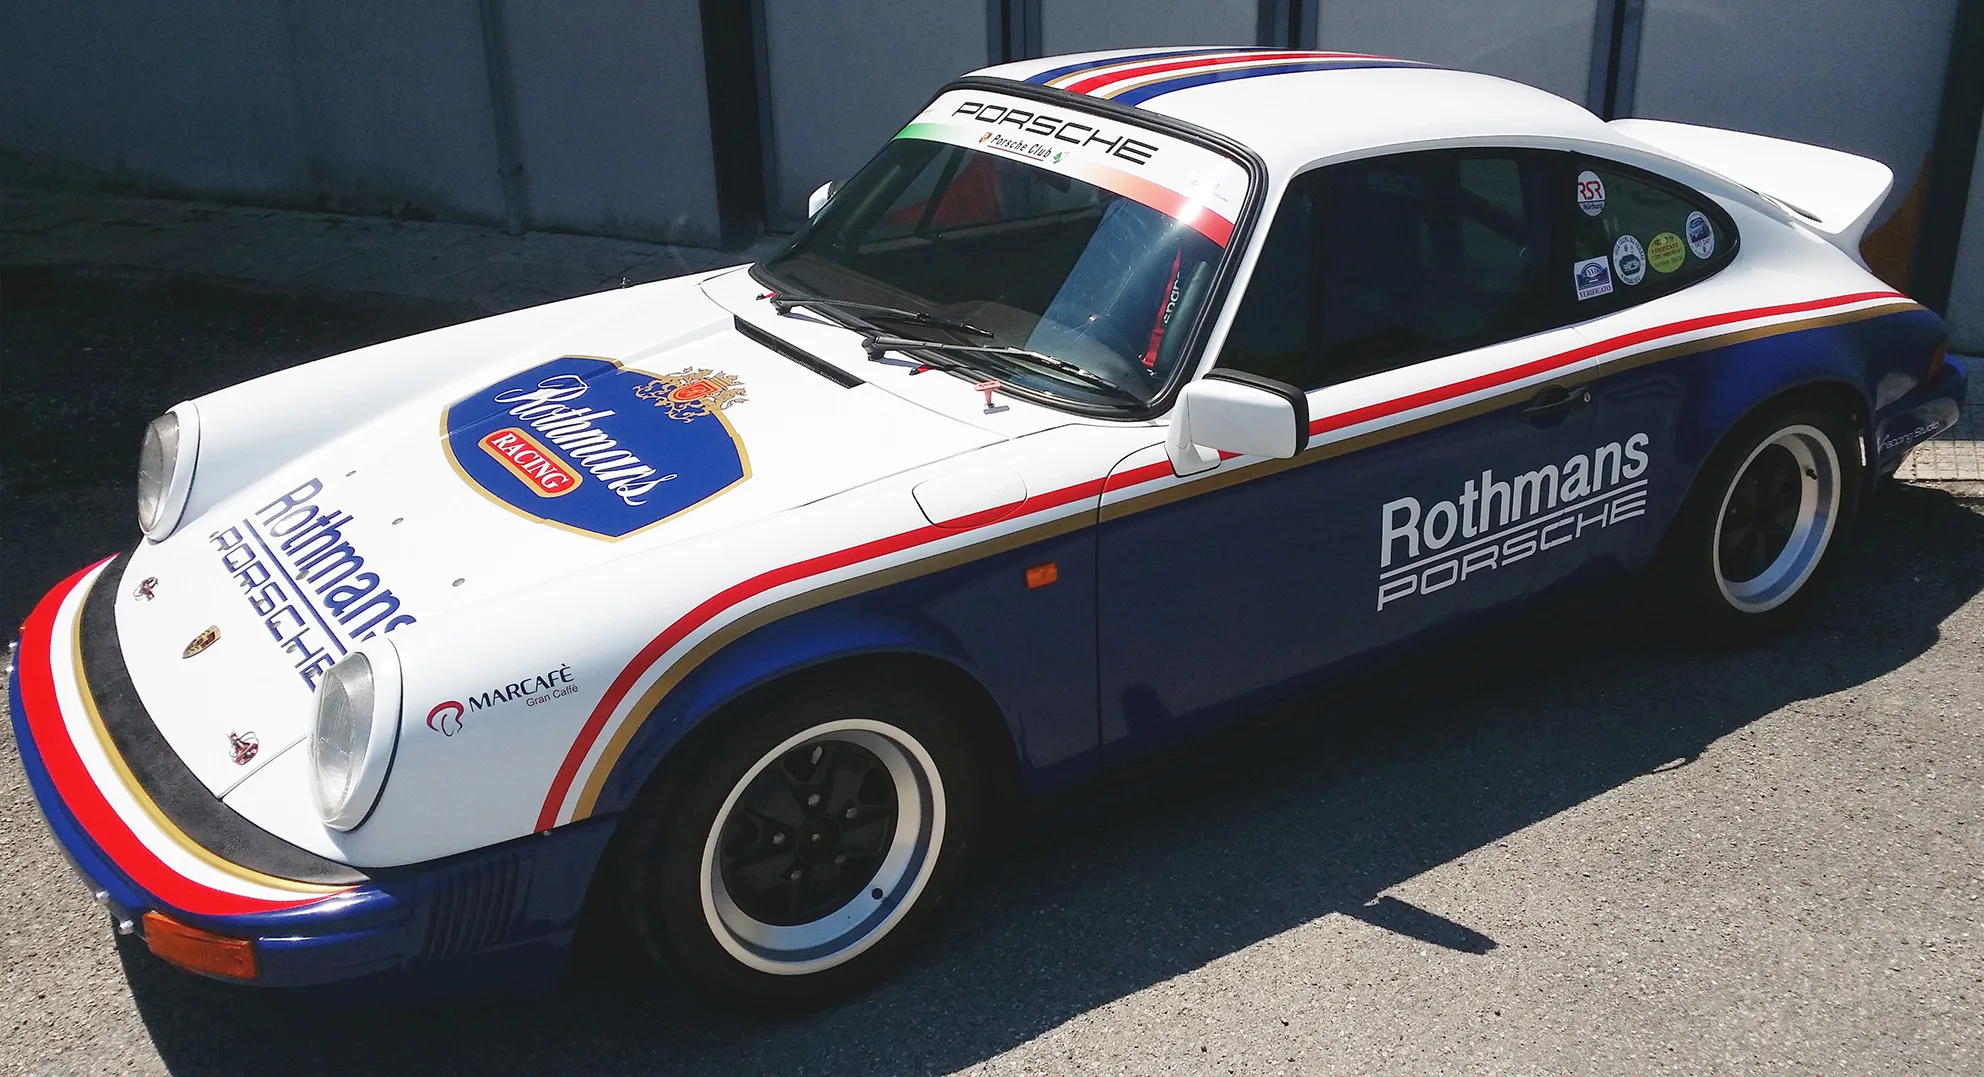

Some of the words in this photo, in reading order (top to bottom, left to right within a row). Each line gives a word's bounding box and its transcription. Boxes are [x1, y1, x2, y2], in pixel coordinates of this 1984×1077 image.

[951, 101, 1159, 166] PORSCHE
[990, 134, 1028, 152] Porsche
[1027, 143, 1053, 159] Club
[1578, 180, 1603, 200] RSR
[490, 432, 569, 491] RACING
[494, 374, 678, 507] Rothmans
[1380, 432, 1649, 568] Rothmans
[1377, 490, 1647, 612] PORSCHE
[209, 525, 335, 693] PORSCHE
[468, 663, 575, 712] MARCAFÈ
[526, 694, 551, 707] Gran
[552, 684, 579, 699] Caffè
